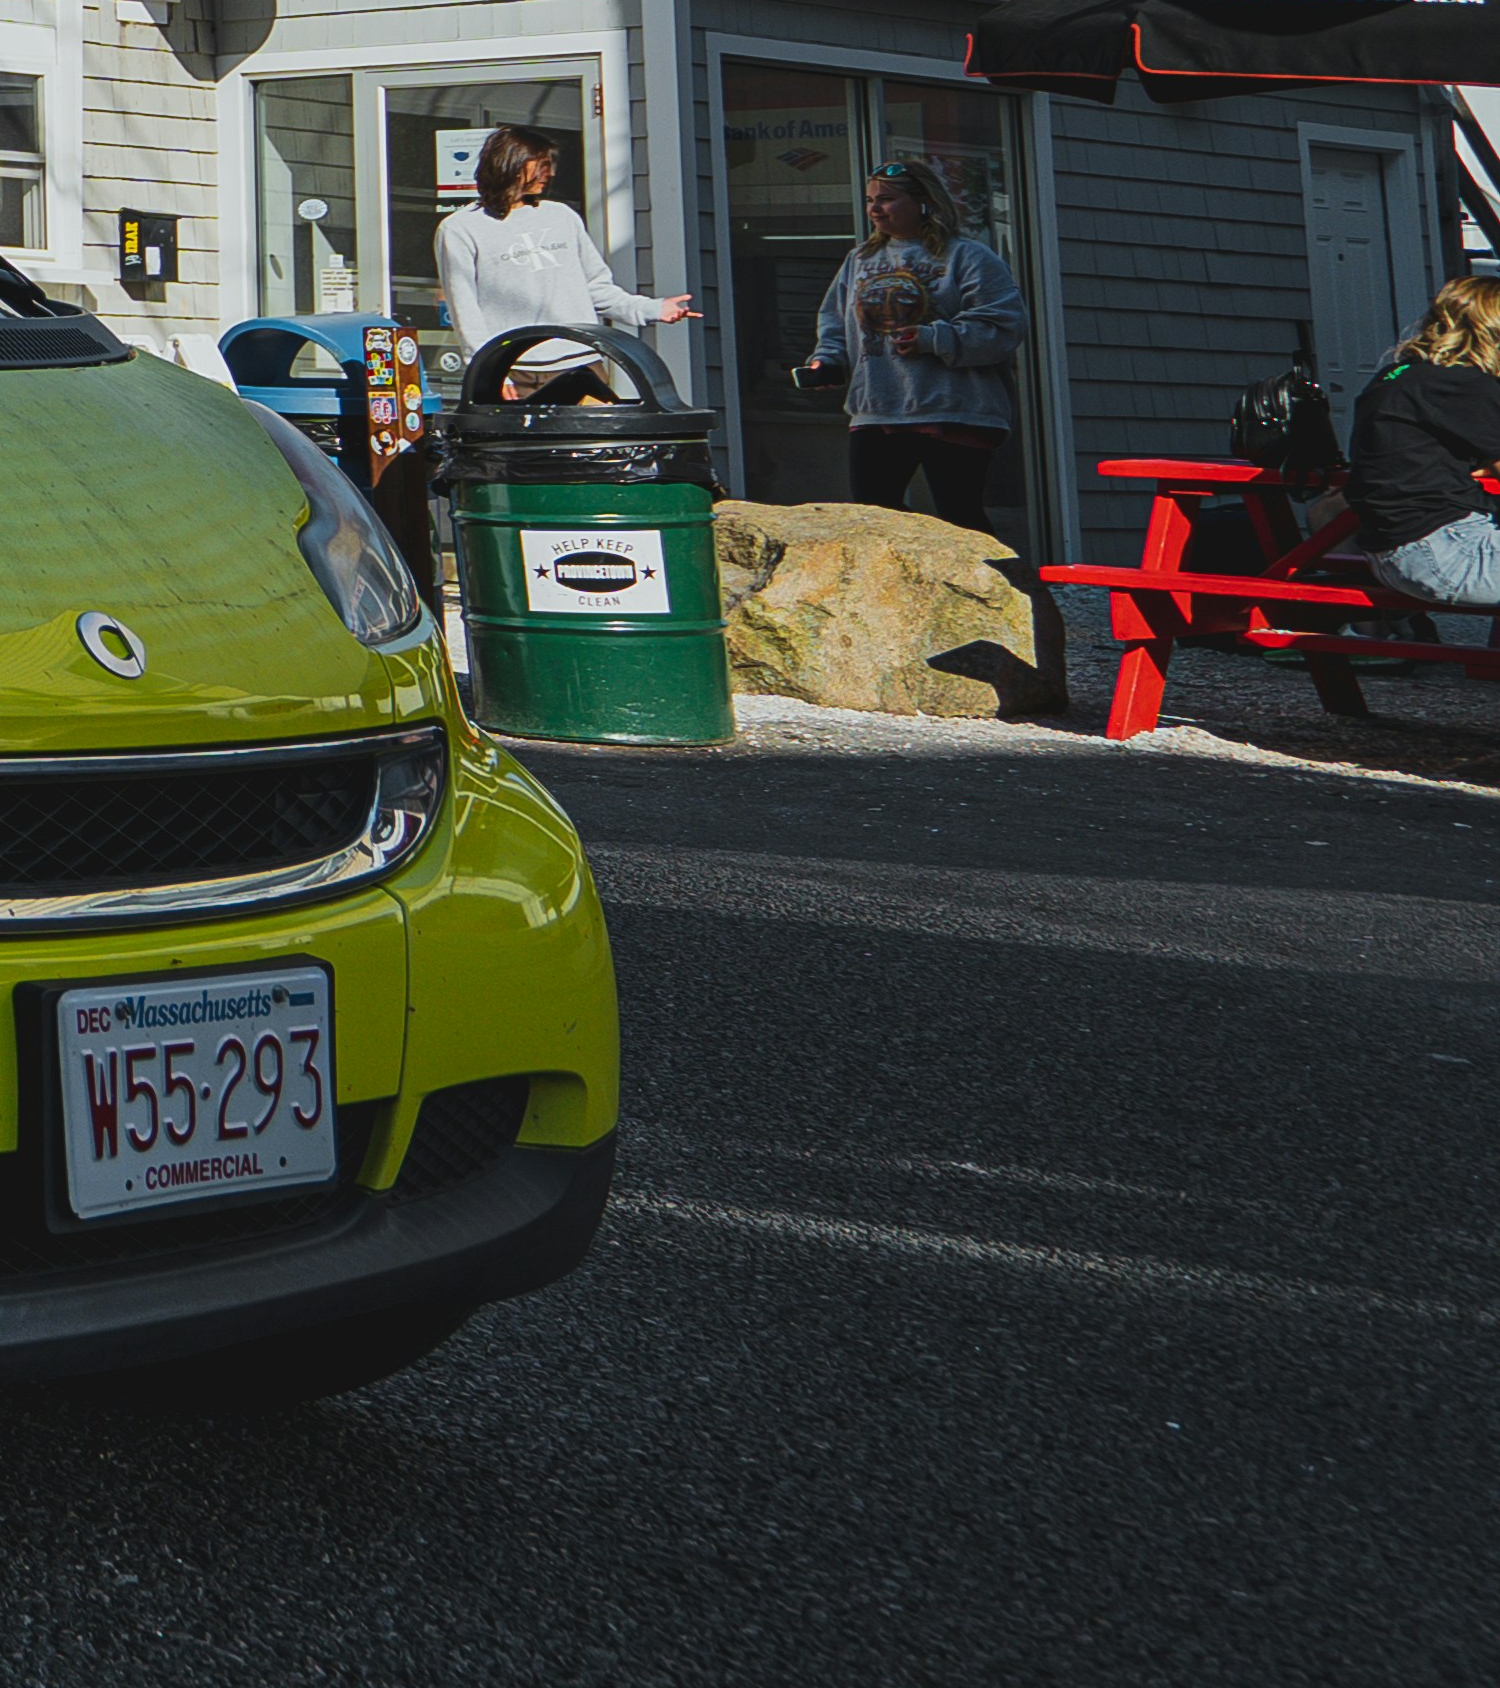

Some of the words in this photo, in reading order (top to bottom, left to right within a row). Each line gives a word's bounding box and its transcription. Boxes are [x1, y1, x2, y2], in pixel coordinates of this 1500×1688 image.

[773, 120, 796, 139] of
[551, 538, 589, 556] HELP
[596, 538, 634, 555] KEEP
[558, 564, 634, 579] PROVINCETOWN
[578, 596, 621, 607] CLEAN
[76, 1007, 111, 1034] DEC
[124, 989, 272, 1029] Massachusetts
[145, 1154, 263, 1191] COMMERCIAL
